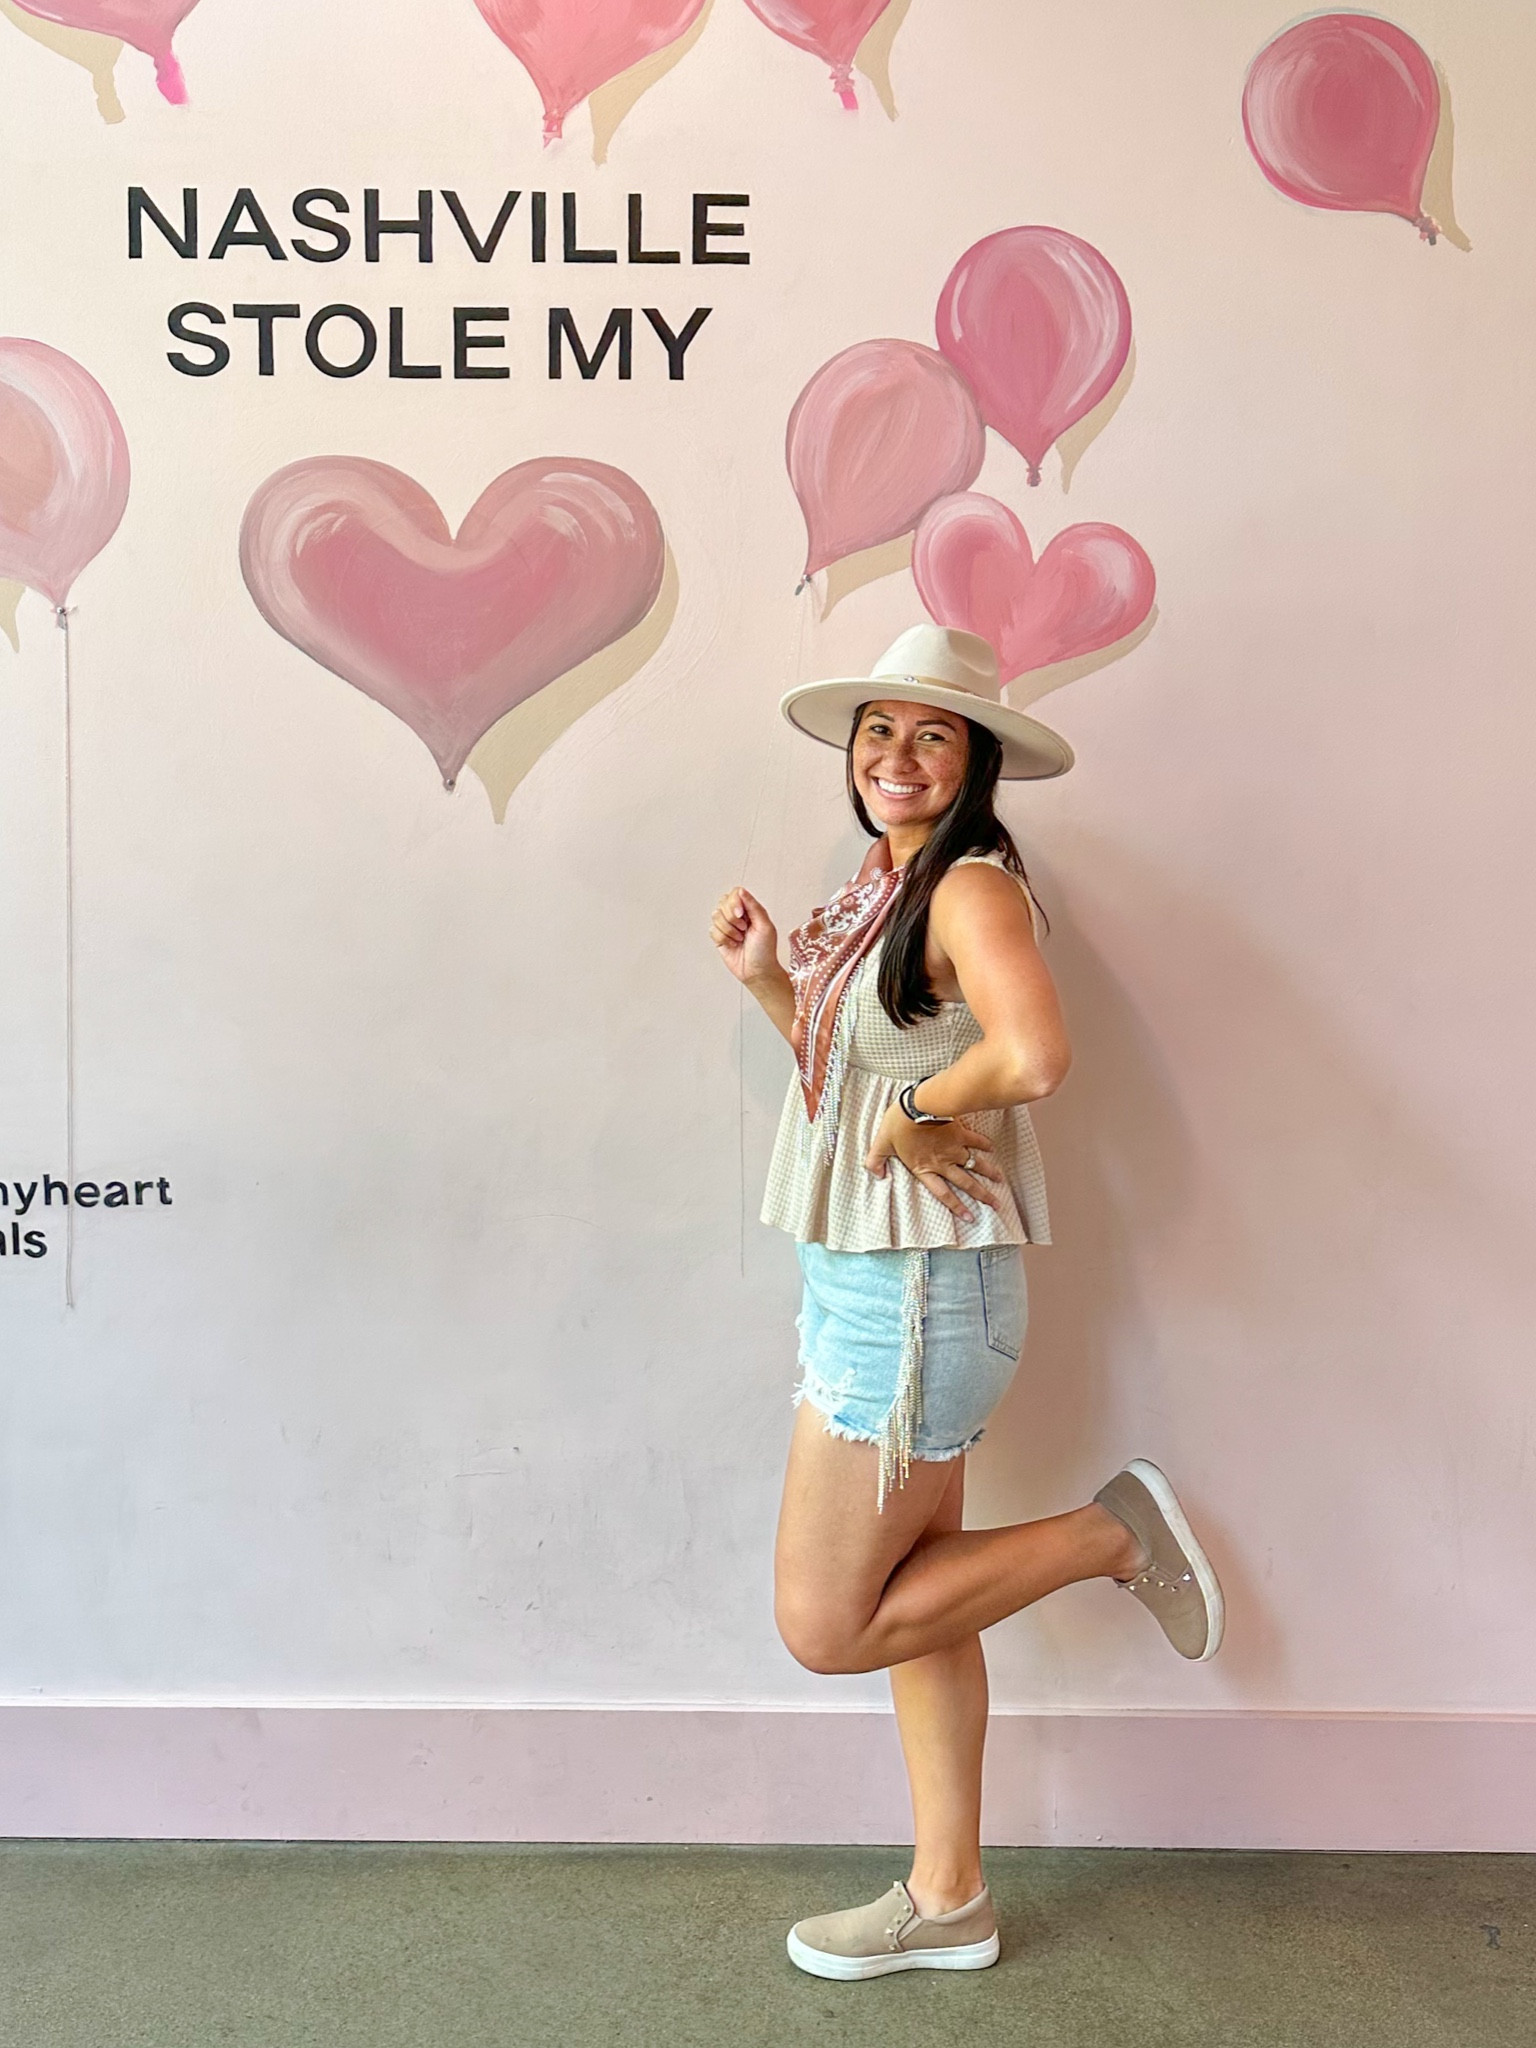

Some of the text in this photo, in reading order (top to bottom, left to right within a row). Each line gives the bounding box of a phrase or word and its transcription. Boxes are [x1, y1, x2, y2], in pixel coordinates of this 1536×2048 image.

[127, 186, 751, 265] NASHVILLE
[166, 301, 713, 381] STOLE MY
[0, 1173, 173, 1216] yheart
[0, 1221, 48, 1259] ls
